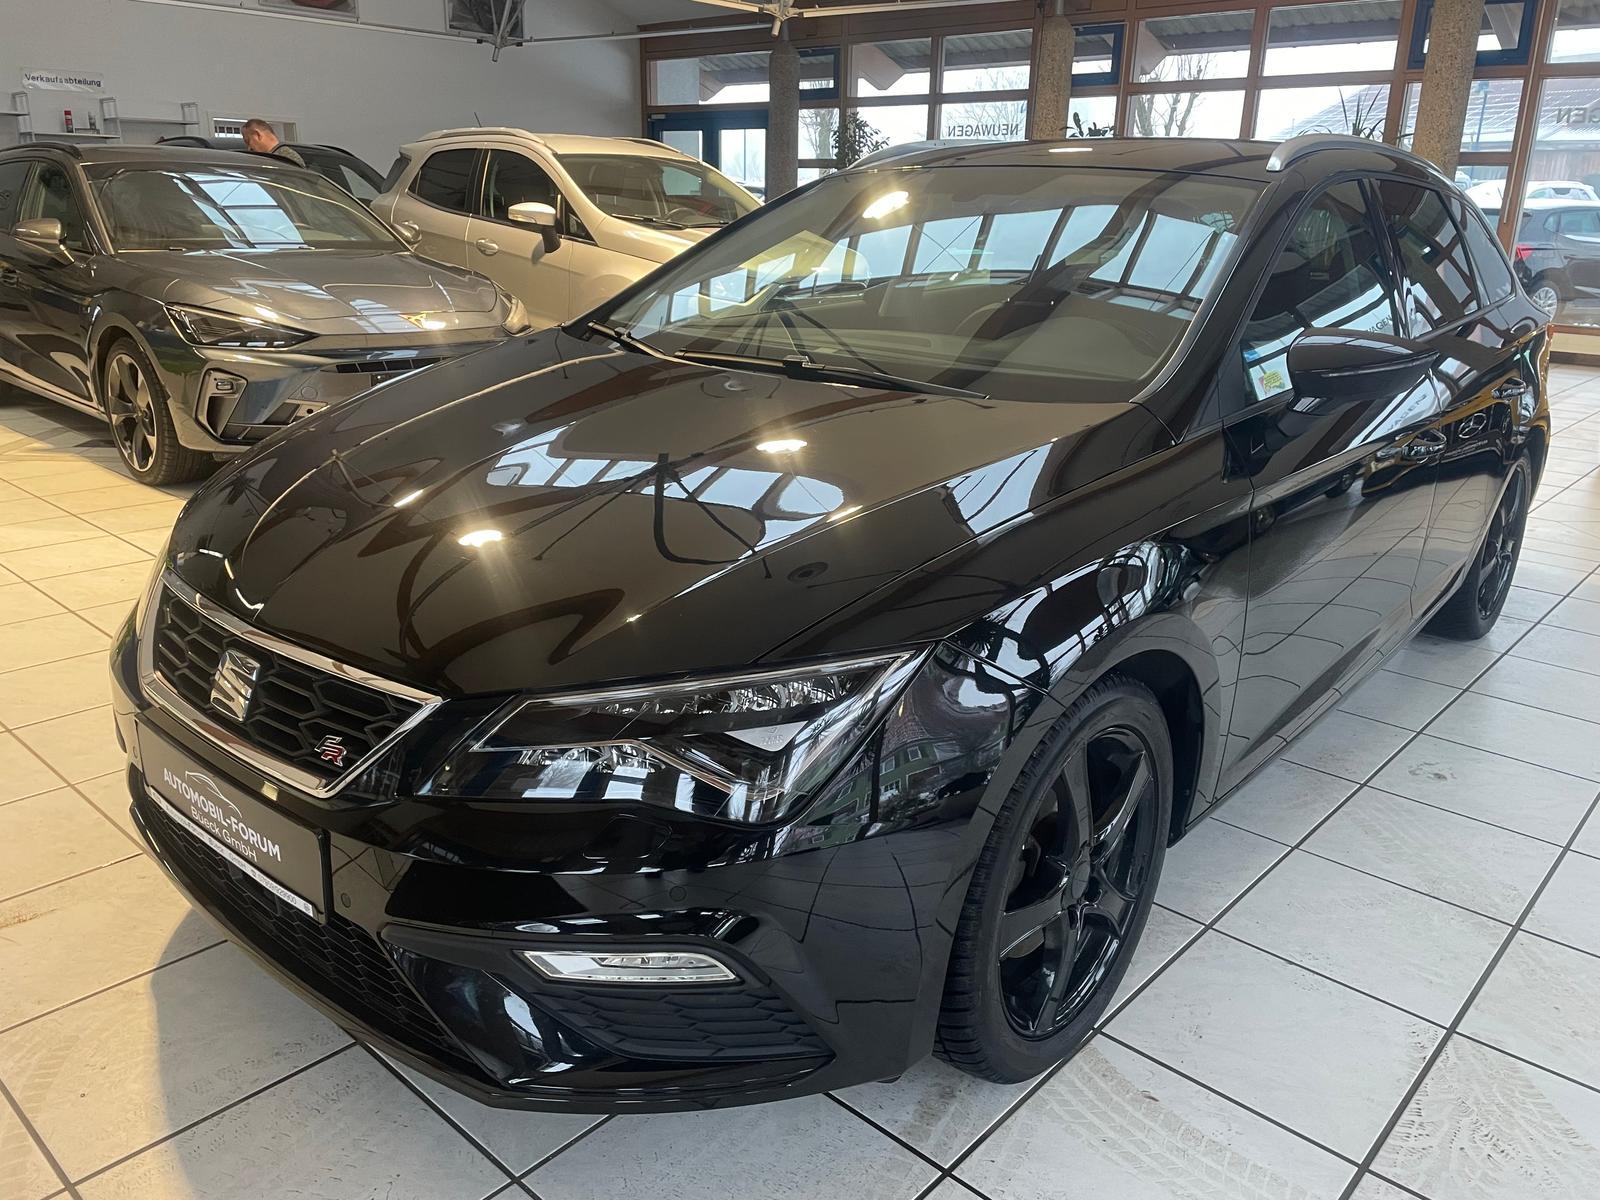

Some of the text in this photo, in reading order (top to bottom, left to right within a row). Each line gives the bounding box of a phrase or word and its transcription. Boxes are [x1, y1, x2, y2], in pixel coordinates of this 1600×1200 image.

[25, 73, 101, 87] Verkaufsabteilung
[1368, 314, 1393, 333] AGEN
[163, 767, 281, 862] AUTOMOBIL-FORUM
[191, 806, 257, 863] Büeck GmbH
